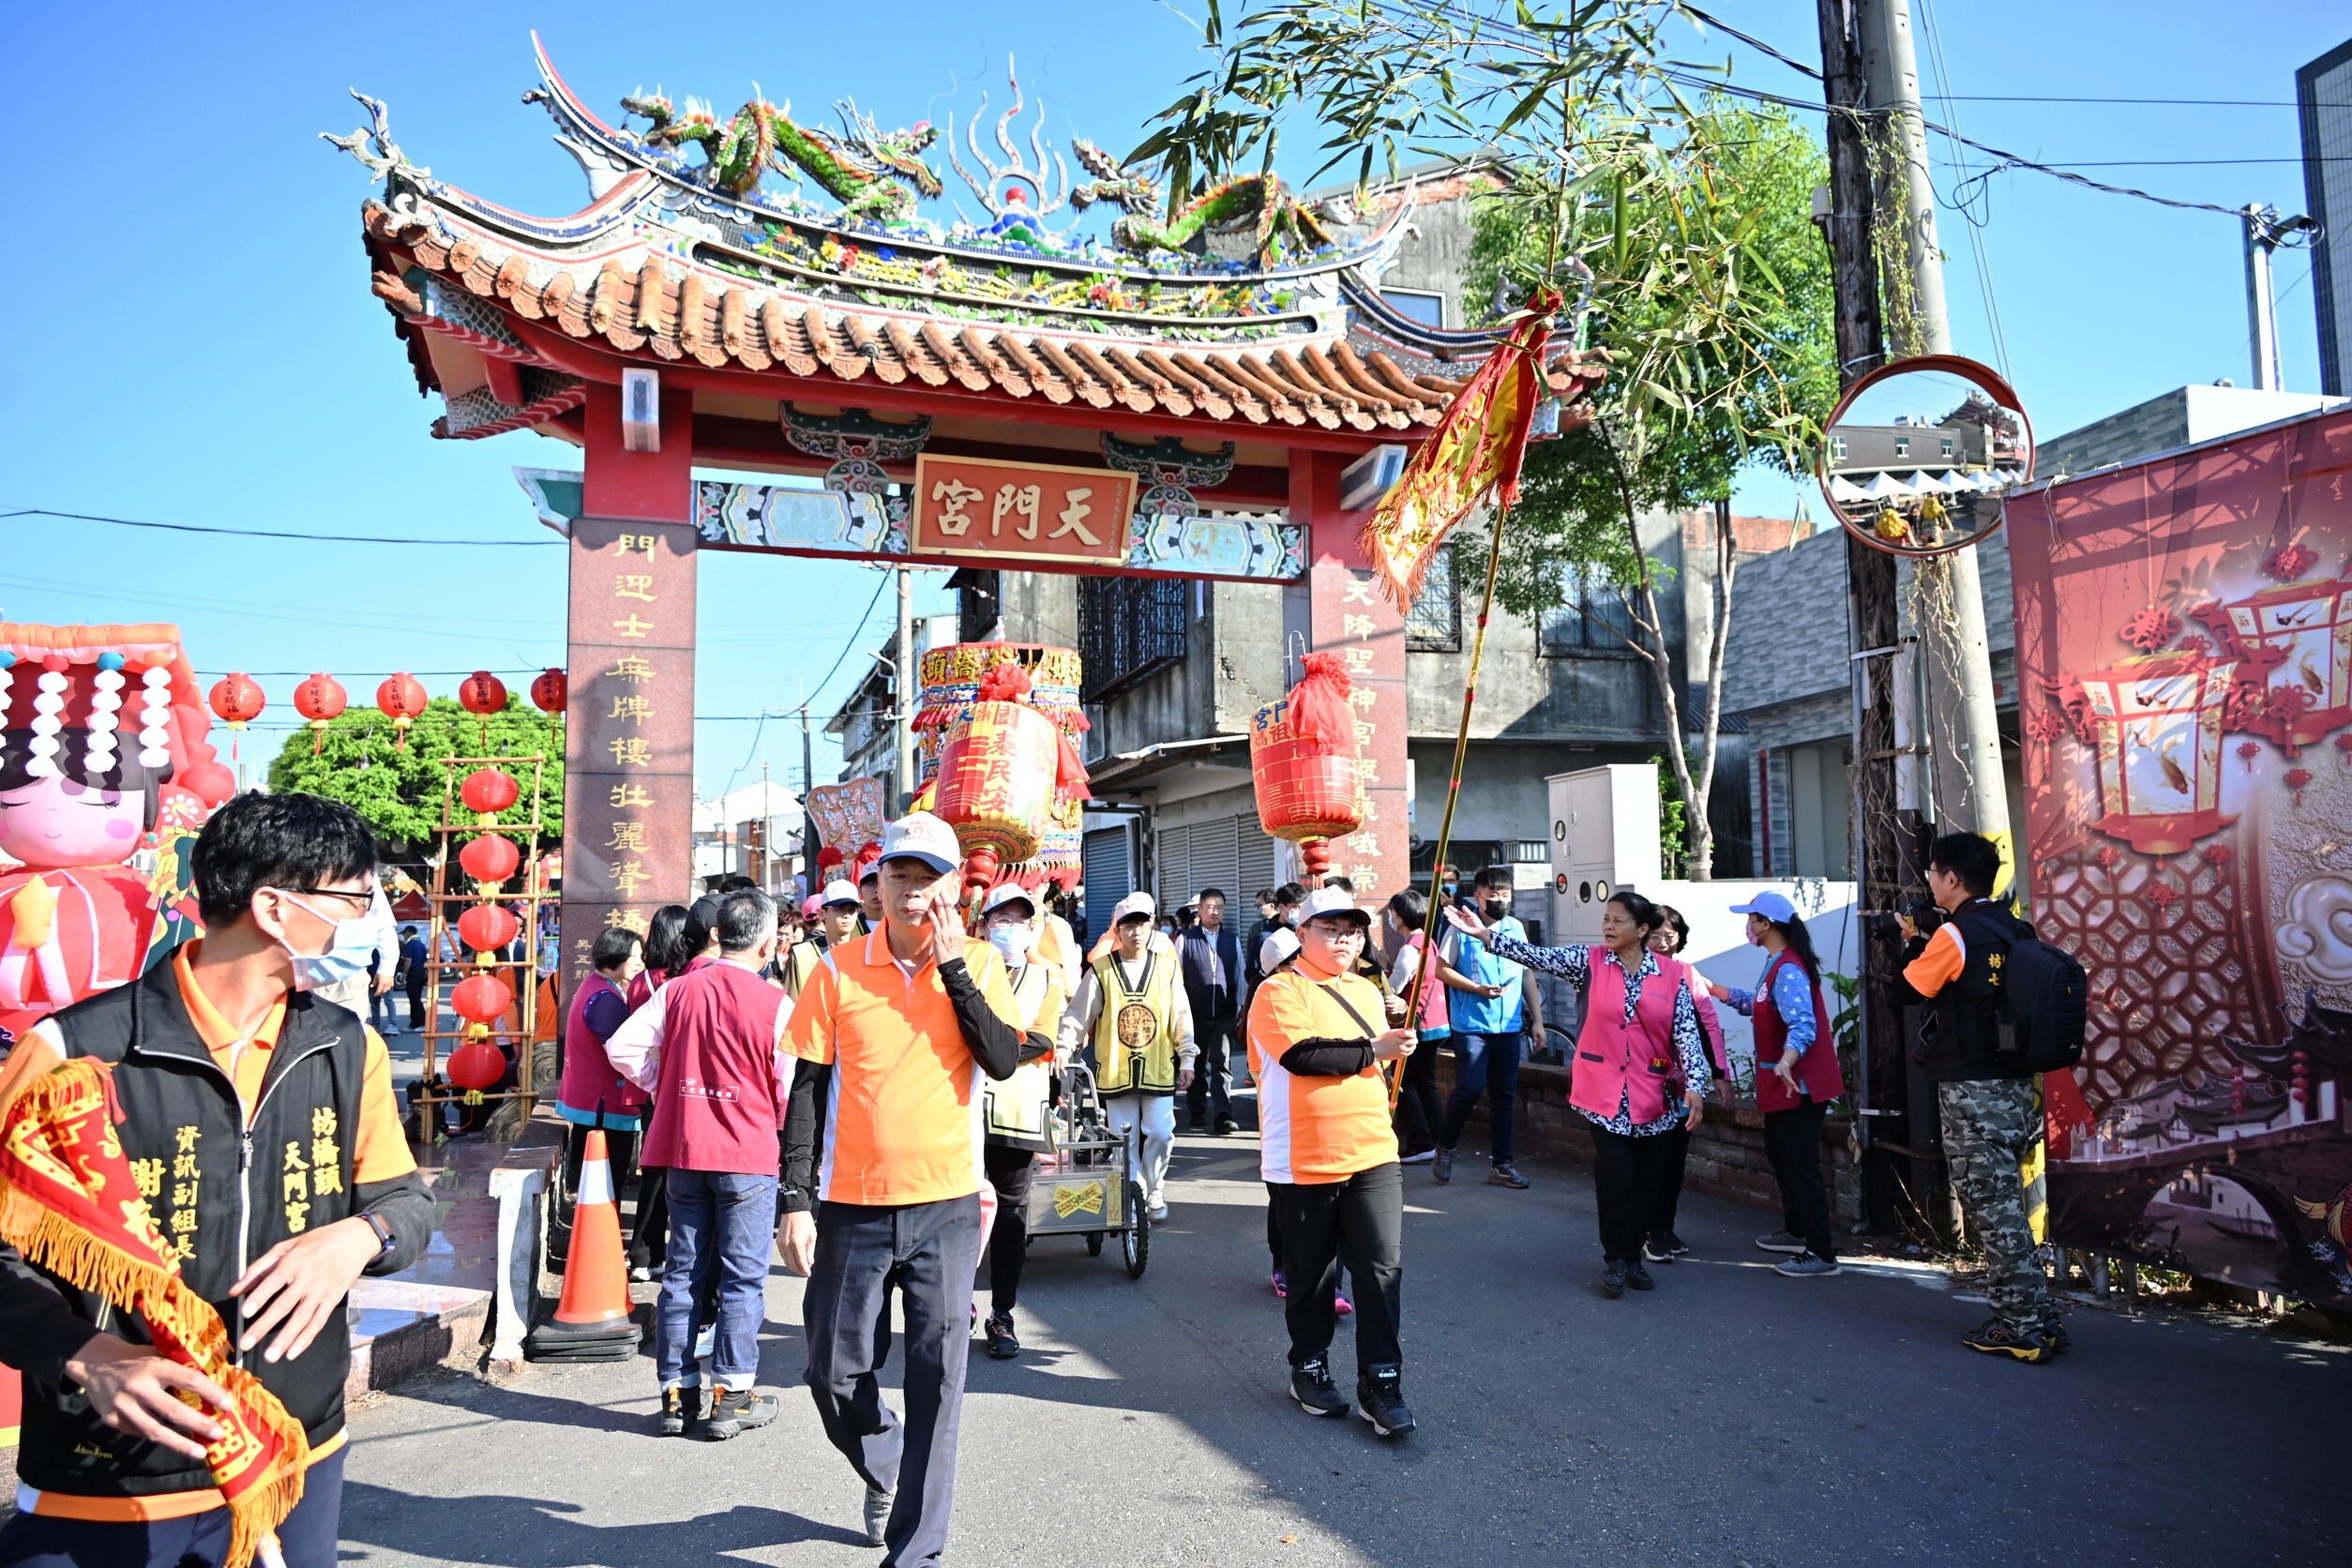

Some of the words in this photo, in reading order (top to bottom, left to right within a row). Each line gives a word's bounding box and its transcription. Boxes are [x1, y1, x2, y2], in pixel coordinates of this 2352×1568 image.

[932, 478, 1102, 546] 天門宮
[225, 680, 239, 713] 天官賜福
[390, 679, 405, 710] 天官賜福
[475, 676, 490, 706] 天官賜福
[980, 703, 1020, 813] 國泰民安
[283, 1141, 310, 1234] 天門宮
[312, 1107, 344, 1196] 枋橋頭
[171, 1125, 202, 1259] 資訊副組長
